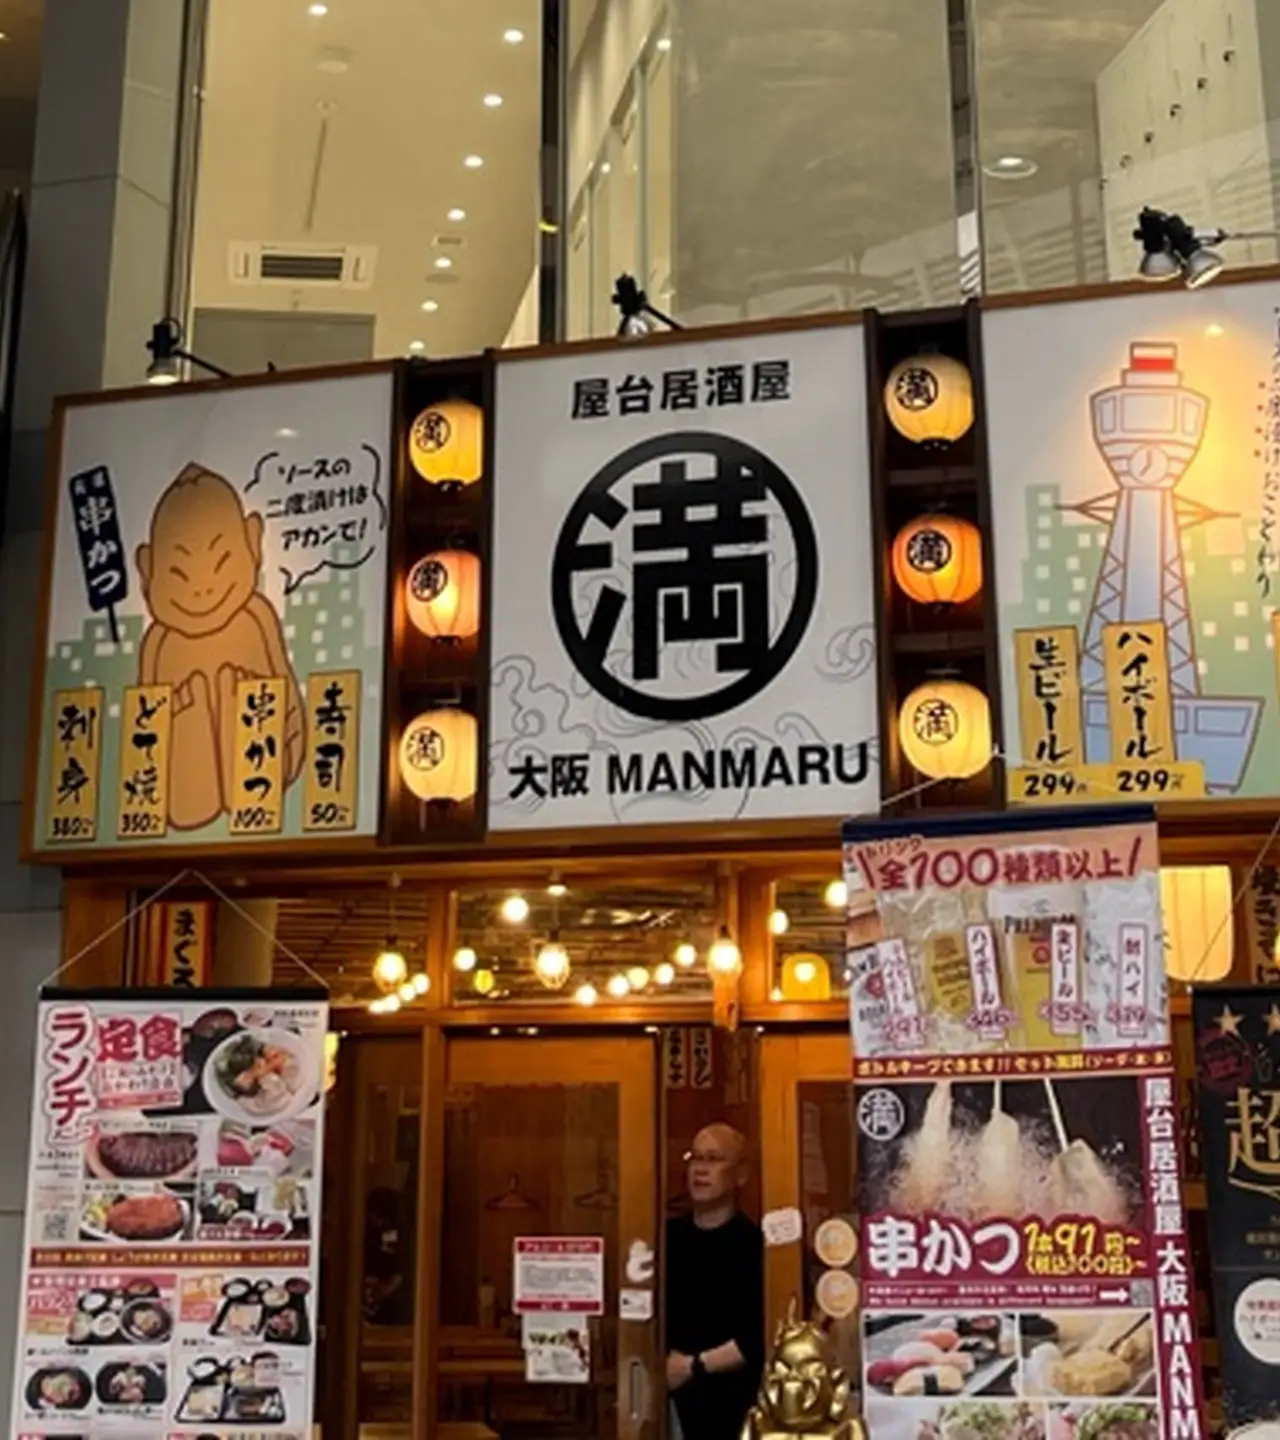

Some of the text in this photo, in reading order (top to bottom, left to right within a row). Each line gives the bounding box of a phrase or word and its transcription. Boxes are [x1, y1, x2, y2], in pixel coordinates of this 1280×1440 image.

[572, 361, 792, 419] 屋台居酒屋
[79, 495, 122, 596] 串かつ
[552, 431, 819, 723] 満
[244, 681, 276, 802] 串かつ
[1029, 637, 1071, 761] 生ビール
[1117, 631, 1164, 759] ハイボール
[508, 743, 869, 800] 大阪 MANMARU
[50, 1012, 91, 1128] ランチ
[96, 1014, 181, 1063] 定食
[868, 1215, 1021, 1278] 串かつ
[1157, 1241, 1189, 1307] 大阪
